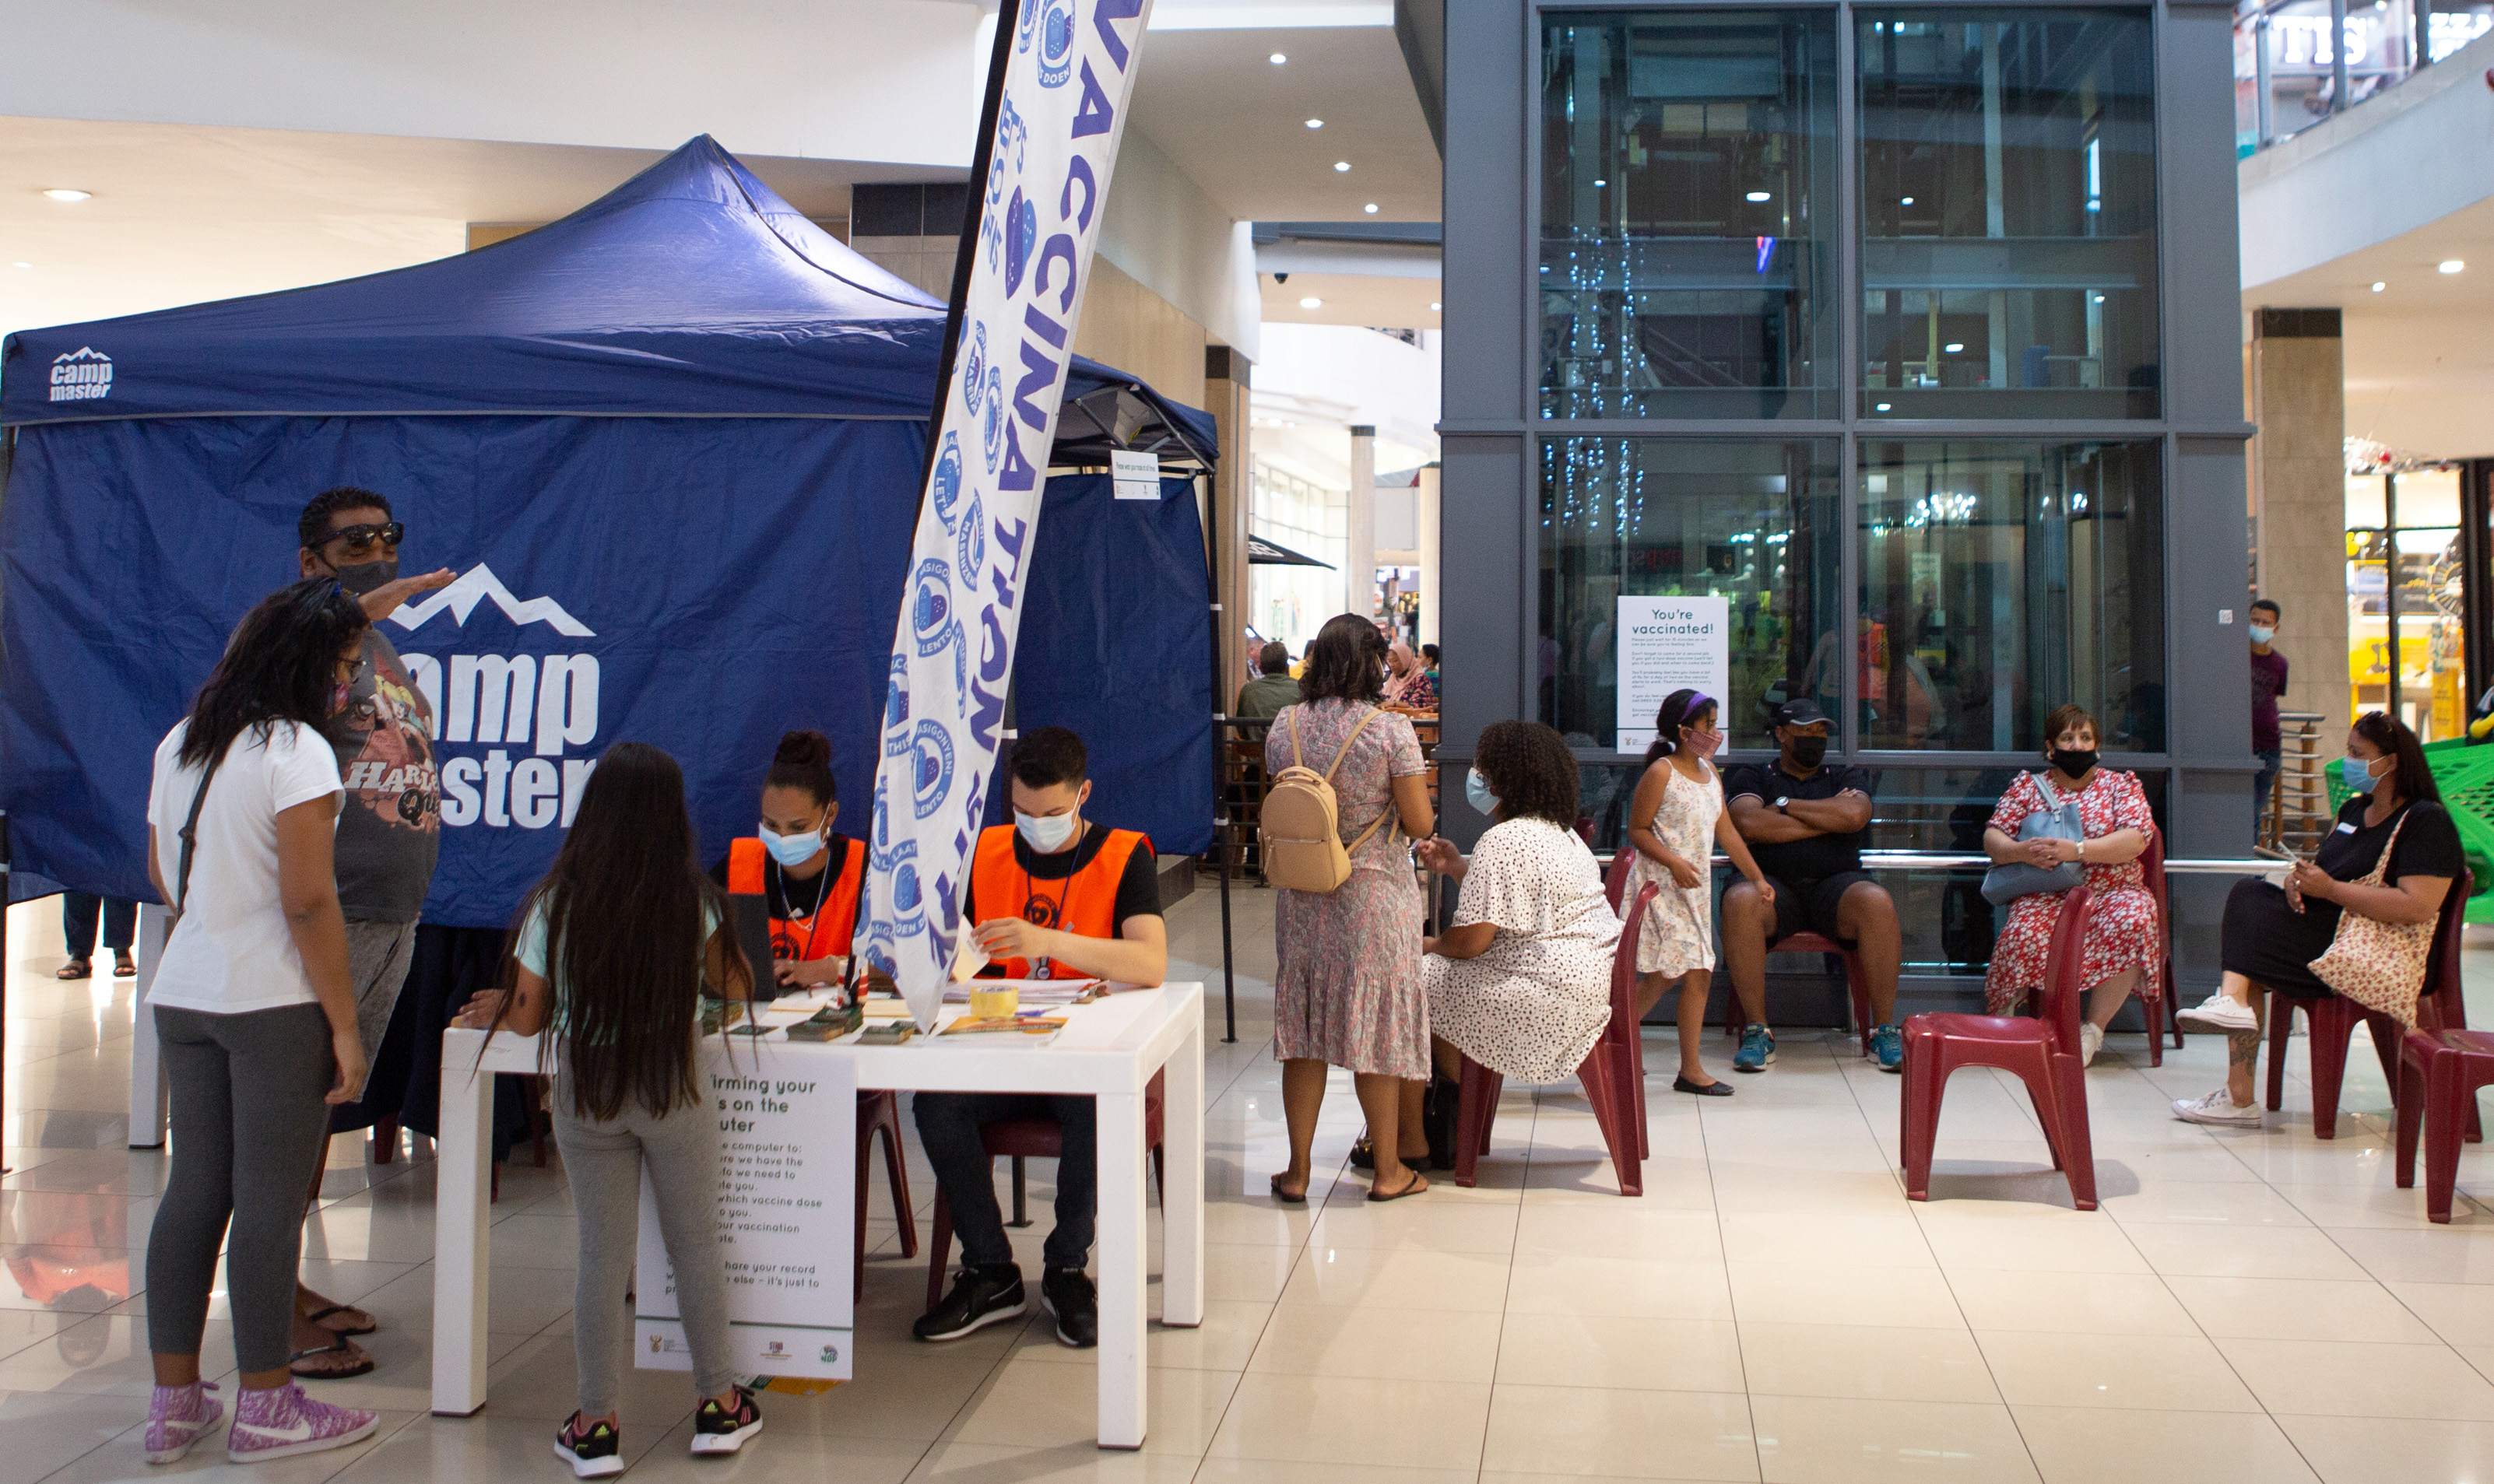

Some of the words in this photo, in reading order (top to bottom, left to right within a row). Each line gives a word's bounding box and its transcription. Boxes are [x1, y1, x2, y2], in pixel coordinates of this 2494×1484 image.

[50, 362, 114, 385] camp
[970, 0, 1143, 753] VACCINATION
[50, 383, 112, 402] master
[1652, 609, 1693, 619] You're
[1632, 623, 1713, 634] vaccinated!
[922, 626, 952, 654] LENTO
[917, 724, 954, 775] ASIGONYENI
[441, 749, 598, 829] ster
[711, 1075, 769, 1094] irming
[776, 1079, 817, 1094] your
[733, 1100, 753, 1112] on
[761, 1099, 789, 1113] the
[720, 1119, 756, 1132] uter
[732, 1142, 784, 1154] computer
[756, 1156, 783, 1166] have
[786, 1156, 803, 1167] the
[736, 1170, 751, 1178] we
[754, 1170, 781, 1179] need
[785, 1170, 796, 1179] to
[752, 1197, 792, 1206] vaccine
[797, 1198, 822, 1208] dose
[738, 1222, 800, 1233] vaccination
[725, 1261, 749, 1272] hare
[753, 1263, 778, 1274] your
[781, 1264, 816, 1274] record
[735, 1275, 755, 1285] else
[768, 1276, 782, 1286] it's
[785, 1277, 805, 1288] just
[809, 1278, 820, 1287] to
